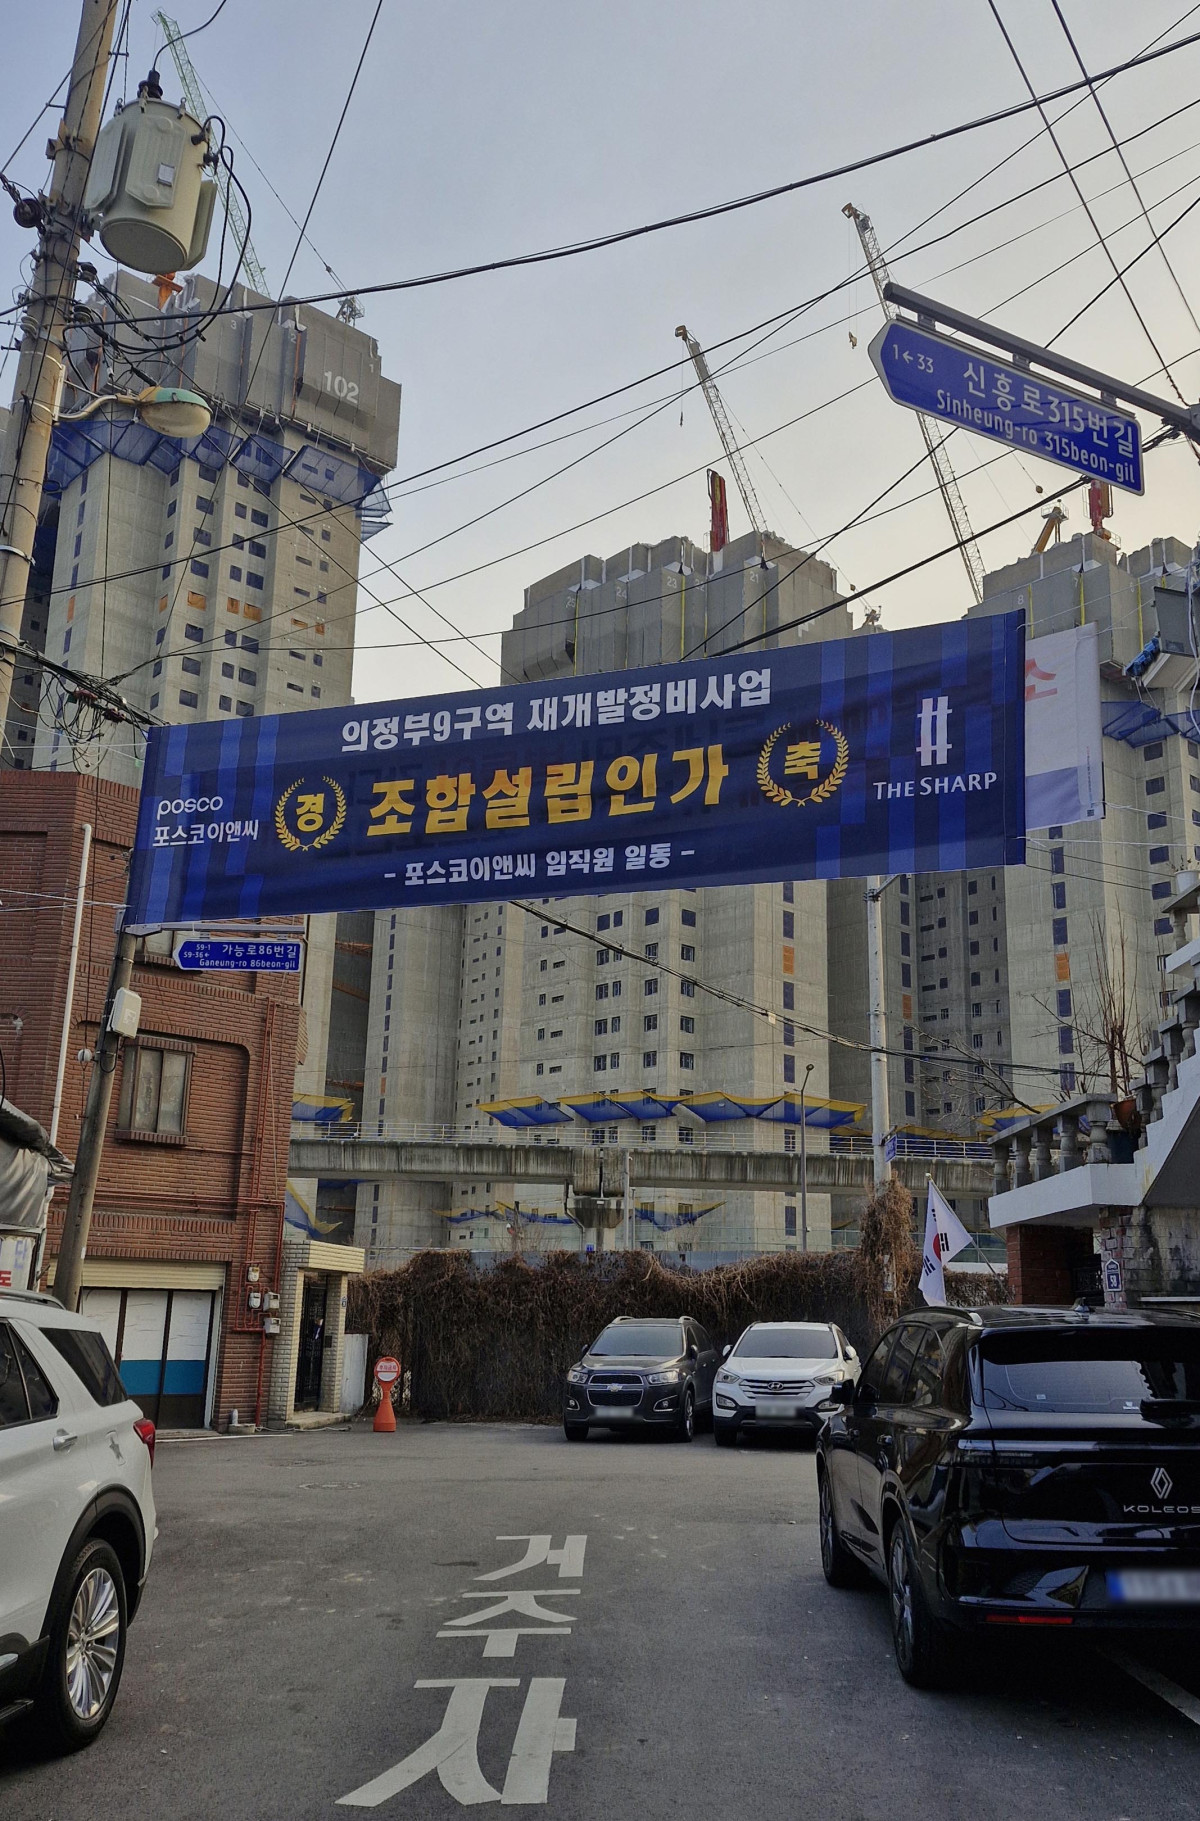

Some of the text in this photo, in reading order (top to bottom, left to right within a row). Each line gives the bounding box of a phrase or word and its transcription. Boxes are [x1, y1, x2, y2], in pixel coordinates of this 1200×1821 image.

[230, 320, 237, 330] 3
[290, 333, 297, 344] 2
[369, 363, 375, 373] 1
[892, 344, 934, 373] 1 33
[324, 371, 359, 404] 102
[963, 362, 1134, 458] 신흥로315번길
[937, 389, 1135, 483] Sinheung-ro 315beon-gil
[666, 576, 677, 589] 23
[750, 571, 759, 584] 21
[1017, 594, 1024, 605] 8
[341, 702, 515, 752] 의정부9구역
[526, 668, 771, 731] 재개발정비사업
[784, 741, 822, 781] 축
[366, 743, 730, 837] 조합설립인가
[873, 771, 998, 800] THE SHARP
[156, 795, 224, 821] posco
[296, 793, 325, 833] 경
[152, 818, 260, 848] 포스코이앤씨
[404, 853, 537, 887] 포스코이앤씨
[546, 846, 615, 876] 임직원
[624, 842, 672, 871] 일동
[199, 959, 296, 970] Ganeung-ro 86beon-gil
[222, 943, 297, 959] 가능로86번길
[1123, 1504, 1200, 1514] KOLEOS
[334, 1534, 588, 1808] 거주자
